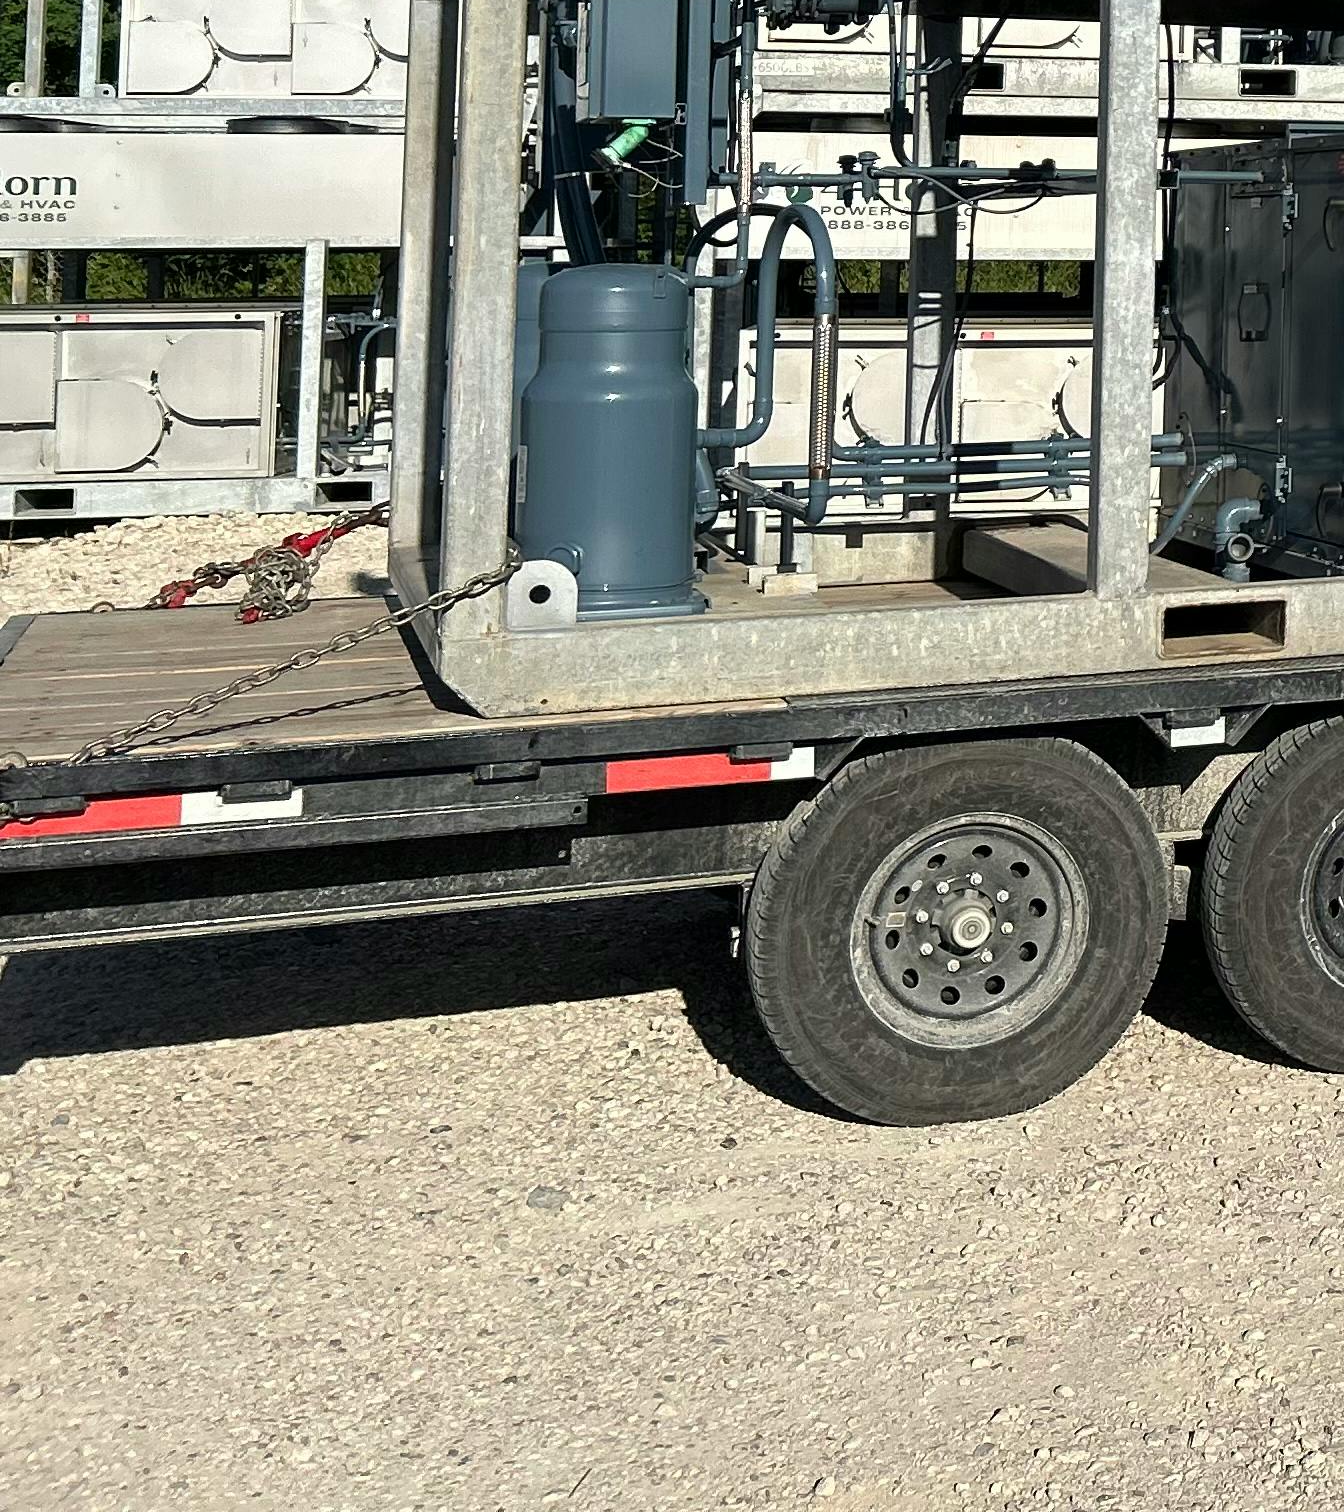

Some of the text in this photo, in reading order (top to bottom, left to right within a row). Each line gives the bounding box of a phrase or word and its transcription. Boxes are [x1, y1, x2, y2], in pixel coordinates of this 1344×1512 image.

[0, 176, 77, 196] orn
[20, 200, 76, 209] HVAC
[821, 206, 892, 216] POWER
